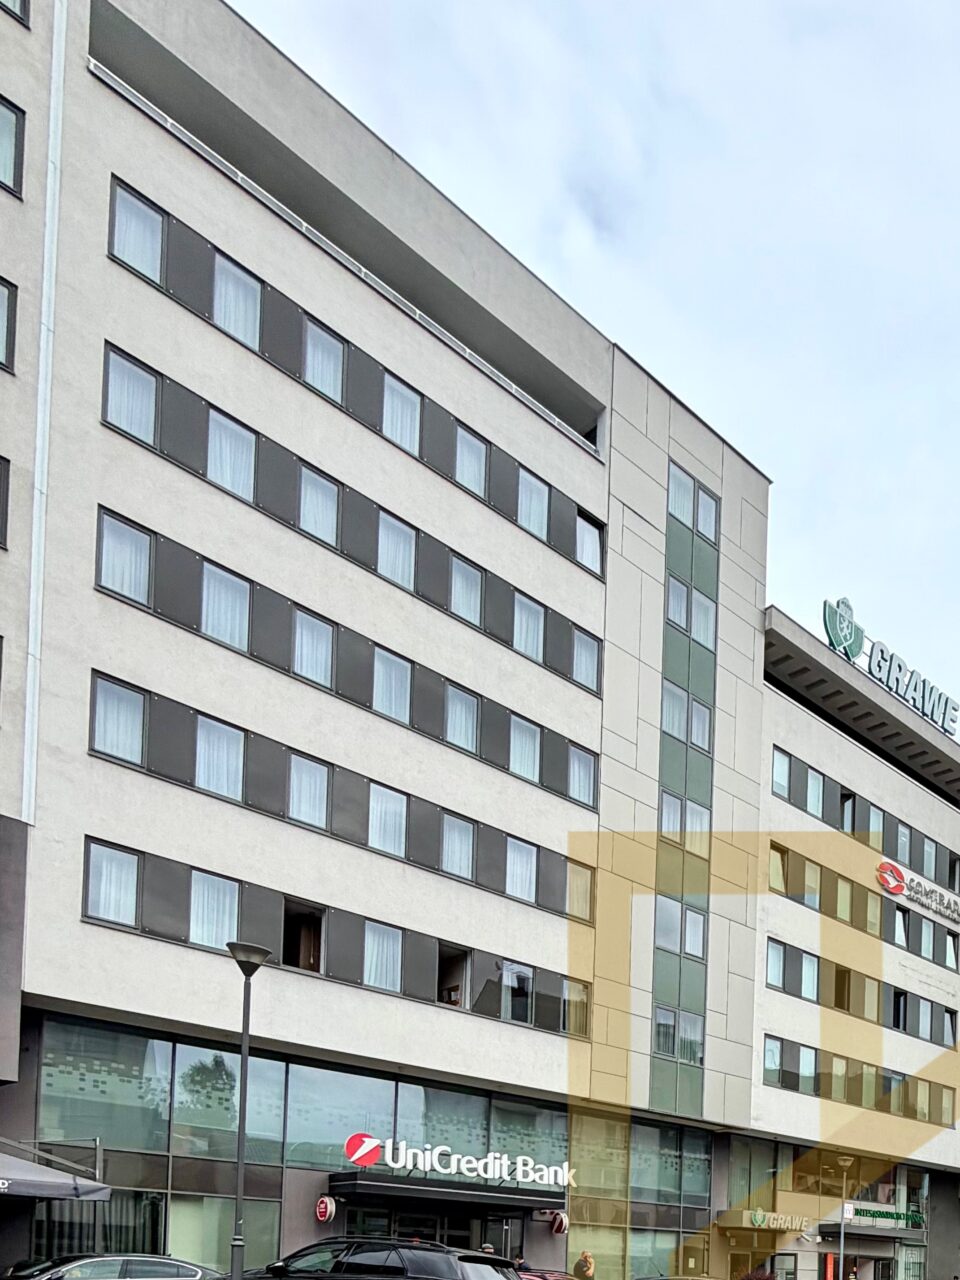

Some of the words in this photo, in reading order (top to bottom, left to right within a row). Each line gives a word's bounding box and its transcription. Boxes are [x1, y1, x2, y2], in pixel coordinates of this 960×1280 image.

[868, 641, 960, 736] GRAWE
[384, 1138, 513, 1181] UniCredit
[516, 1155, 578, 1188] Bank
[768, 1213, 809, 1231] GRAWE
